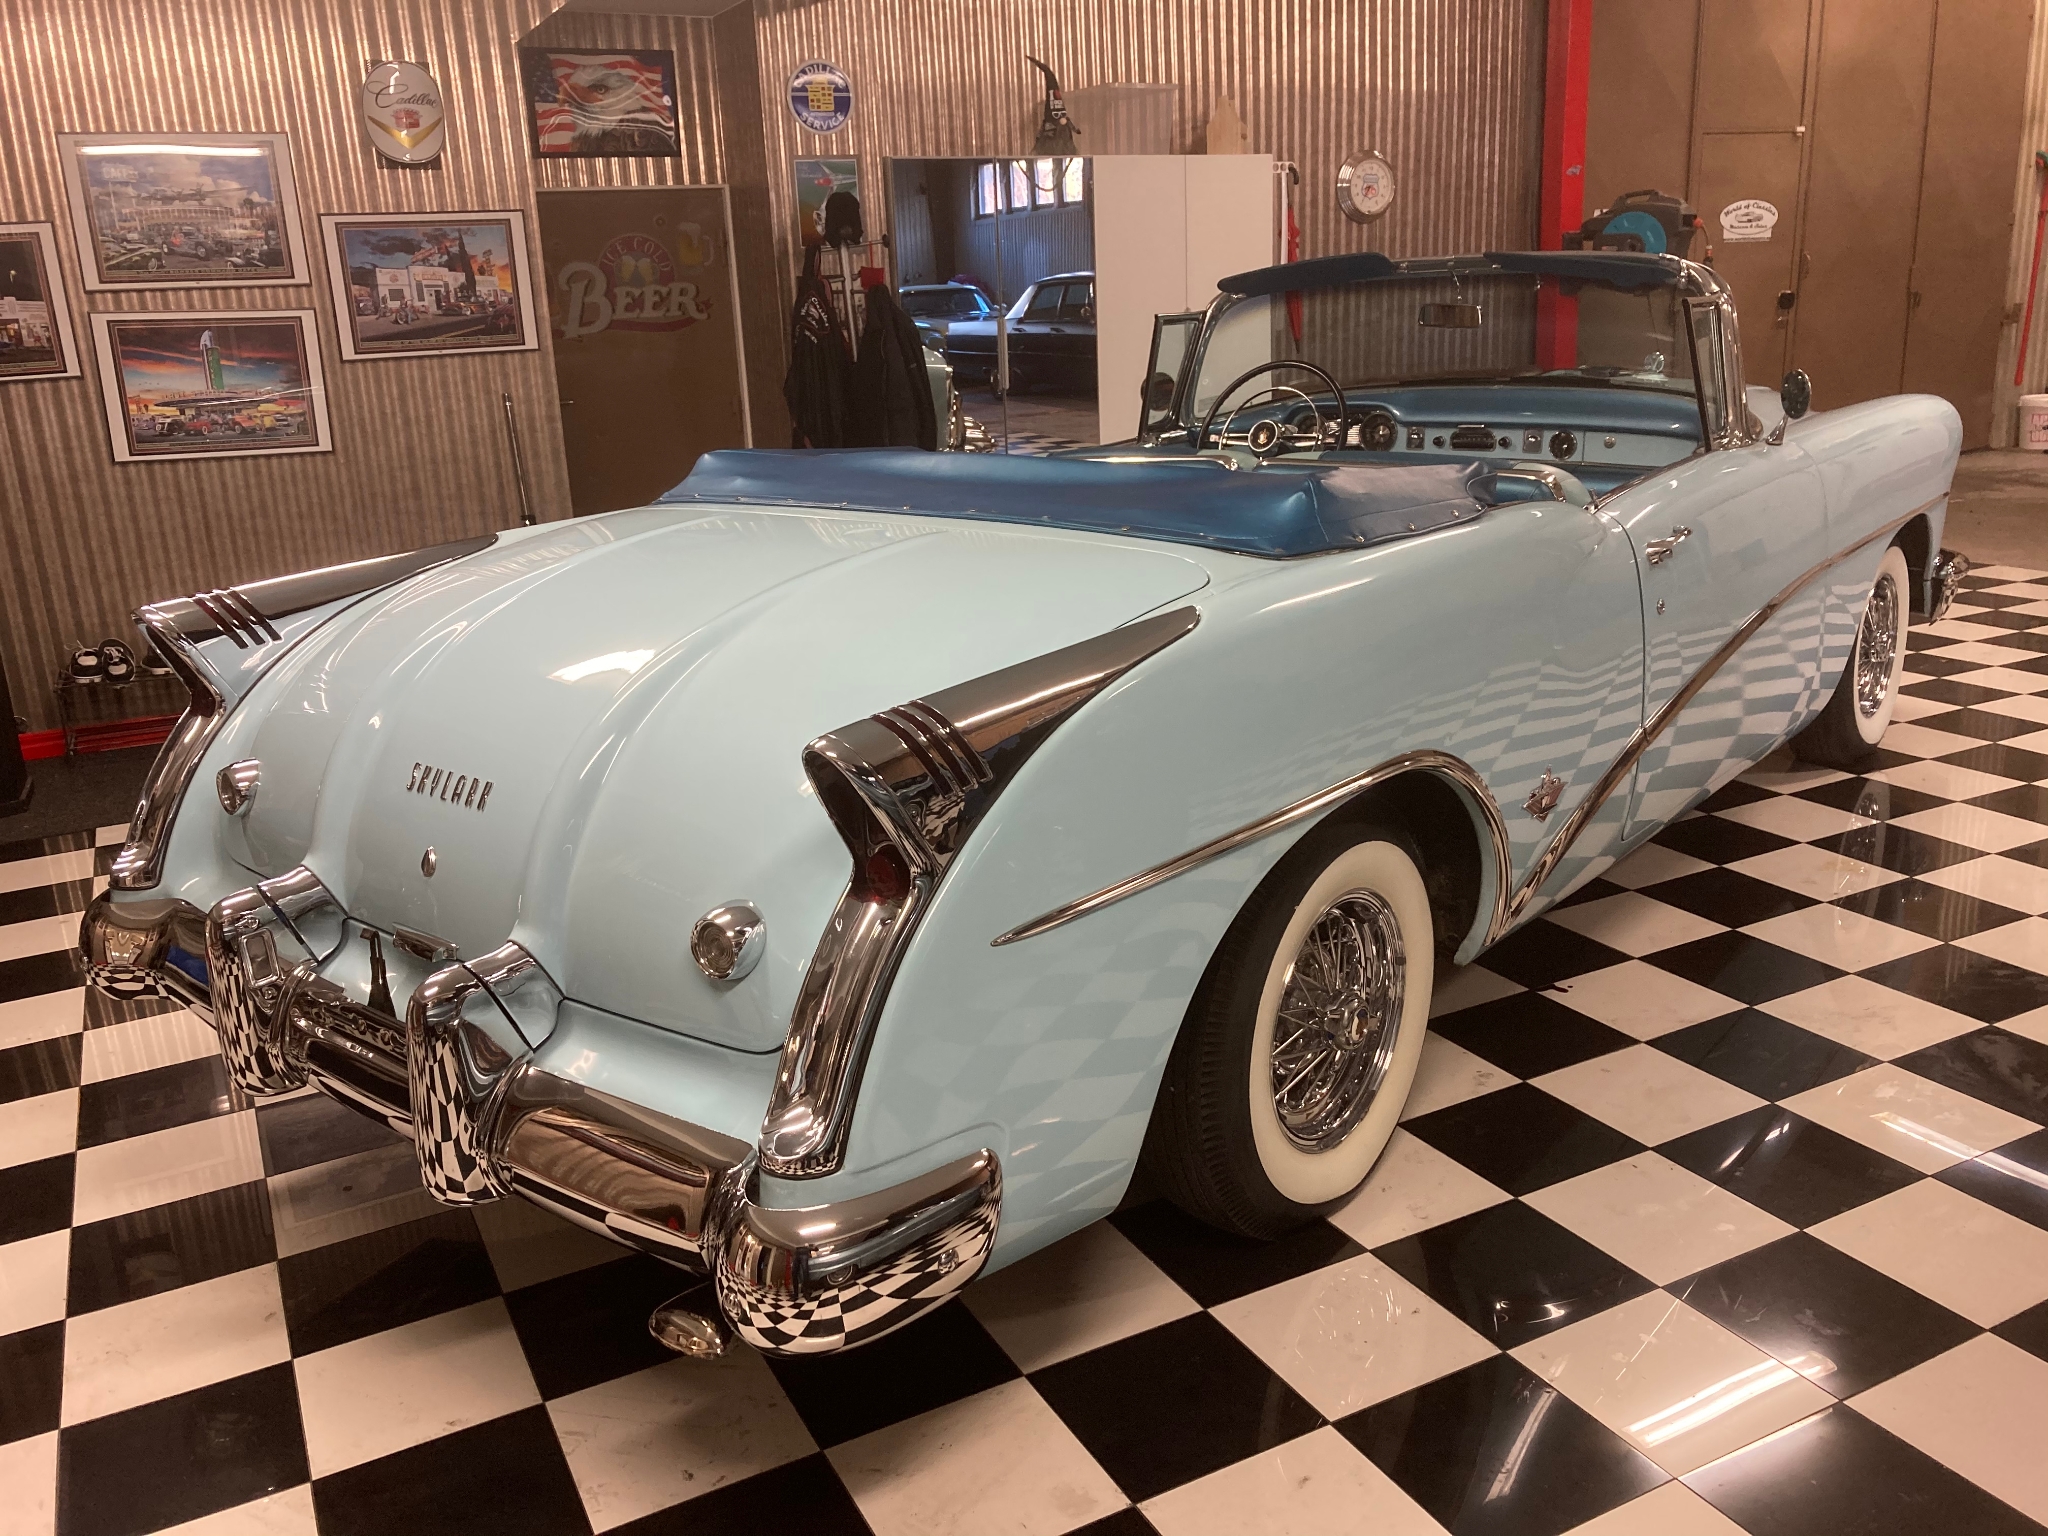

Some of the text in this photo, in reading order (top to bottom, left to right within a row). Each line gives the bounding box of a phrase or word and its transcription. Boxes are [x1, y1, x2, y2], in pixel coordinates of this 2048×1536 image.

[793, 64, 848, 88] CADILLC
[366, 81, 438, 109] Cadillac
[800, 112, 845, 130] SERVICE
[1723, 204, 1742, 217] World
[1752, 202, 1776, 217] Classics
[602, 237, 672, 271] ICE COLD
[558, 261, 711, 339] BEER
[406, 762, 494, 812] SKYLARK
